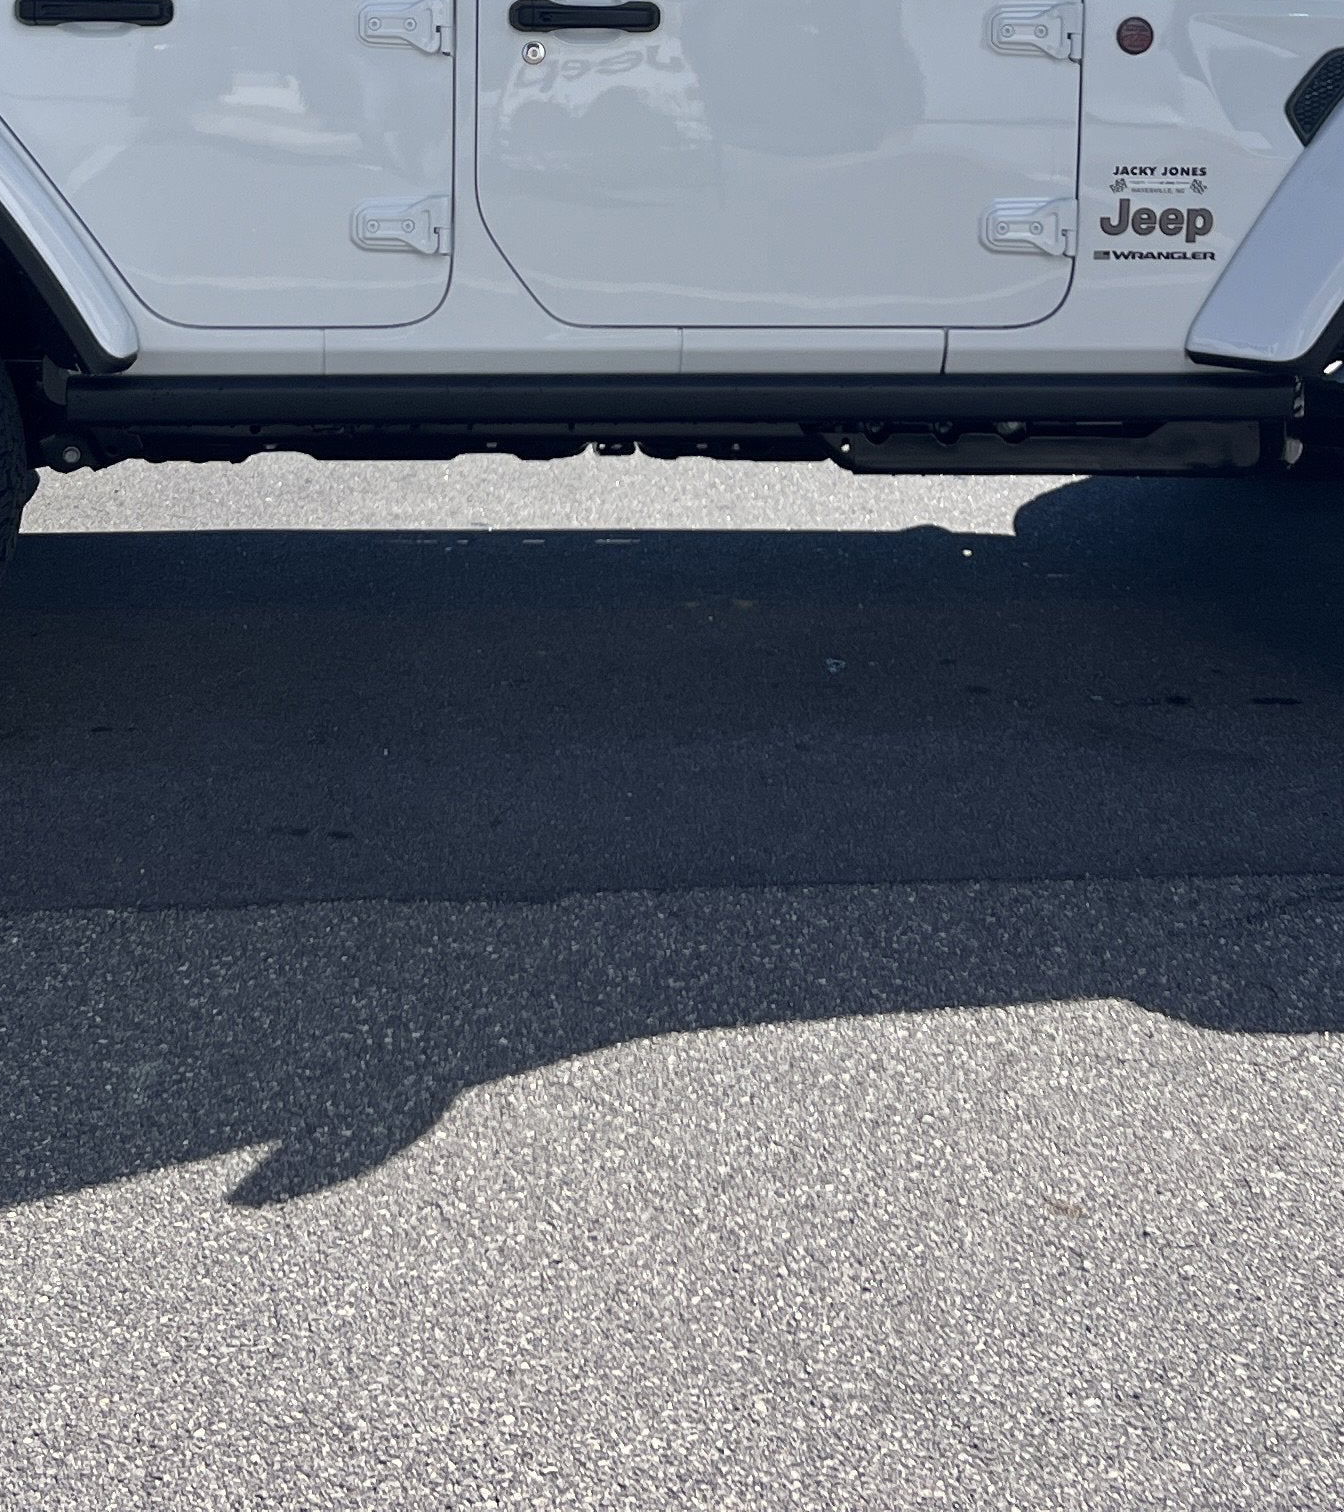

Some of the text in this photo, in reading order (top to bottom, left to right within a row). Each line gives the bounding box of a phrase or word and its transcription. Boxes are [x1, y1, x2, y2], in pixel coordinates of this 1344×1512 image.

[1113, 166, 1207, 177] JACKY JONES
[1100, 198, 1214, 243] Jeep
[1112, 250, 1216, 261] WRANGLER
